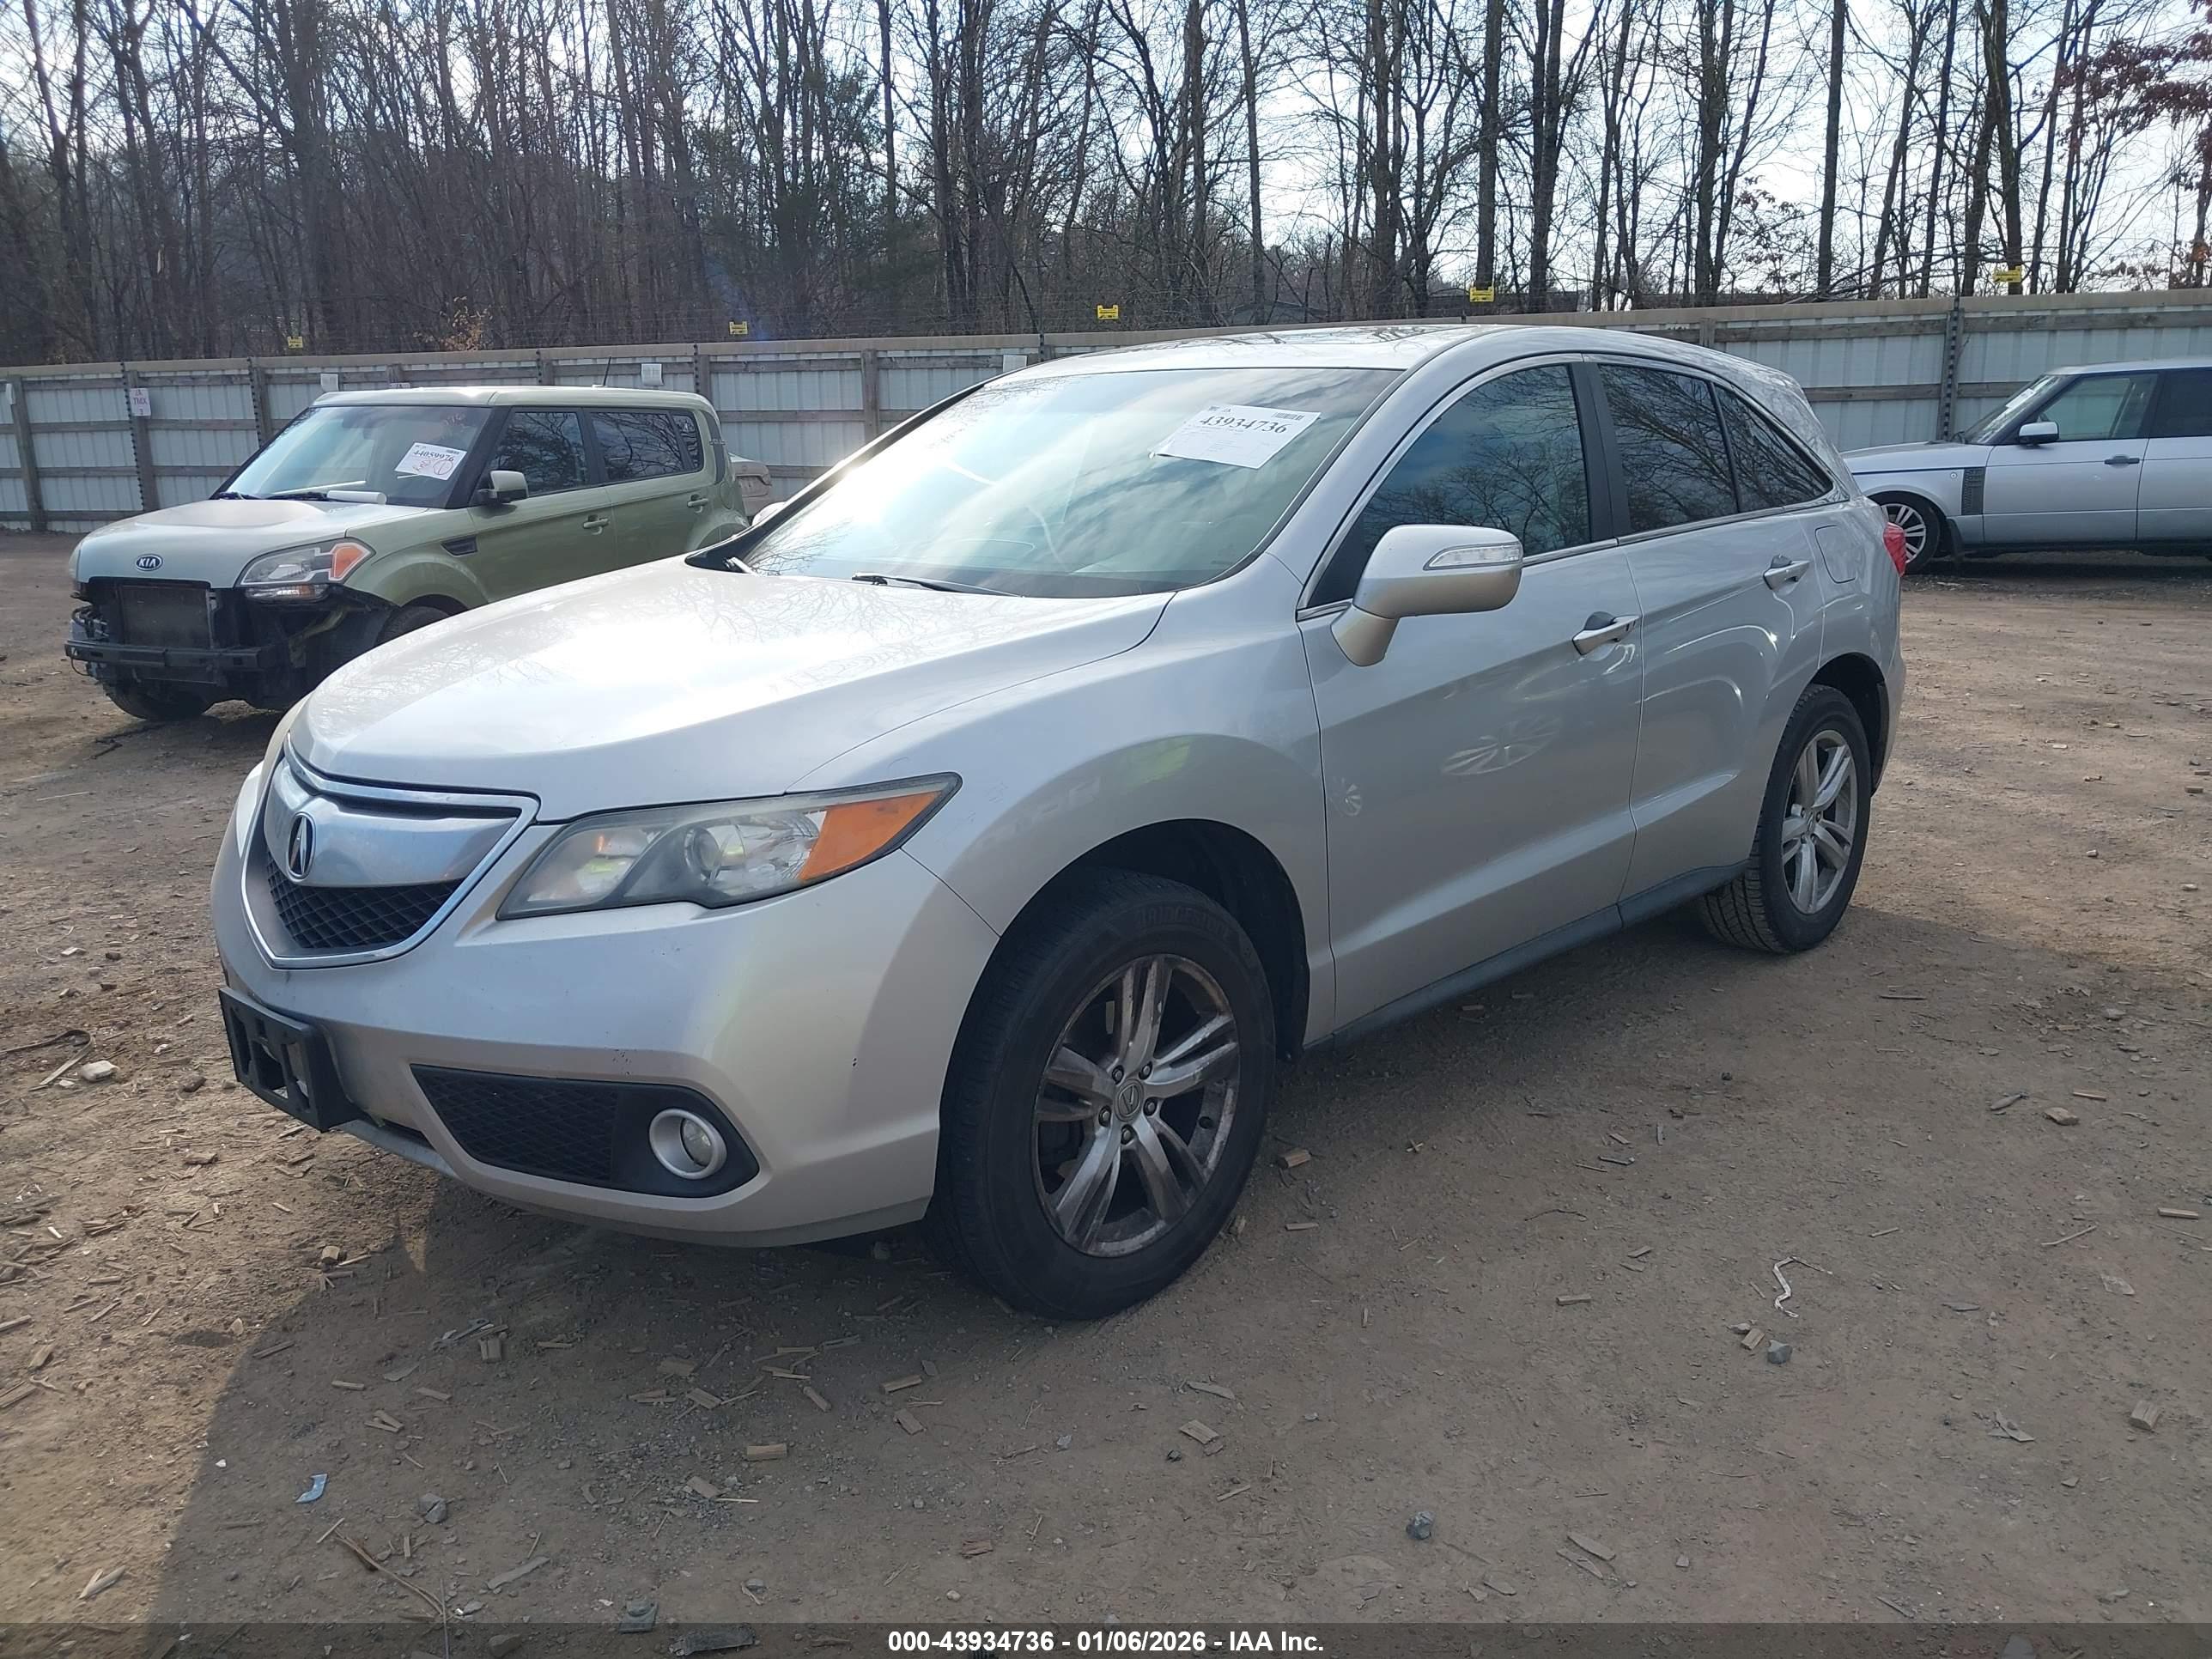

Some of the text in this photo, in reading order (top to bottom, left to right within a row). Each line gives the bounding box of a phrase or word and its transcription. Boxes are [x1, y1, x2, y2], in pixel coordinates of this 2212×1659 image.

[1199, 415, 1291, 434] 43934736
[413, 449, 454, 462] 44059976
[138, 557, 157, 568] KIA
